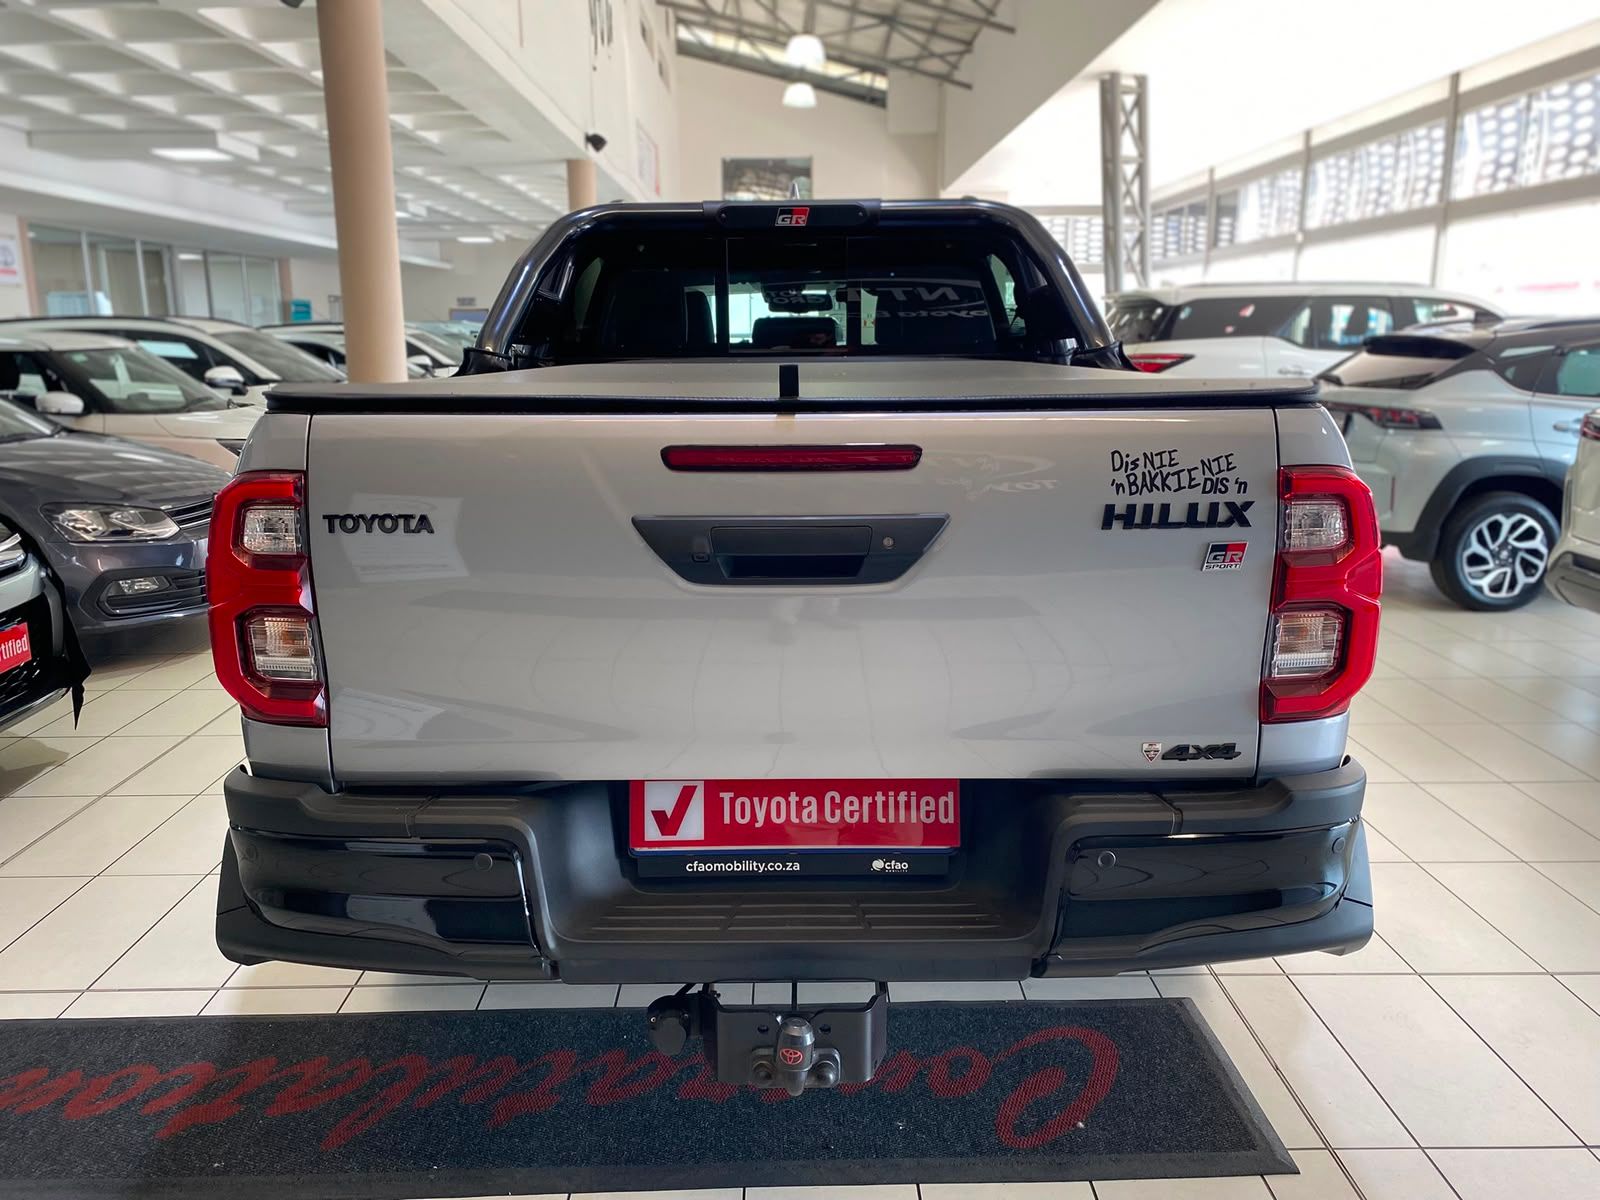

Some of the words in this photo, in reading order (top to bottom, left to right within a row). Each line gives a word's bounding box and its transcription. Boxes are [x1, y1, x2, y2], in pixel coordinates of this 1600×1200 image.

[777, 214, 806, 225] GR
[1110, 449, 1140, 473] Dis
[1142, 449, 1180, 470] NIE
[1126, 466, 1202, 497] BAKKIE
[1200, 453, 1237, 476] NIE
[1201, 477, 1230, 495] DIS
[322, 513, 435, 534] TOYOTA
[1101, 500, 1255, 530] HILUX
[1207, 550, 1245, 564] GR
[1205, 563, 1241, 571] SPORT
[719, 790, 818, 828] Toyota
[824, 790, 954, 824] Certified
[686, 860, 801, 874] cfaomobility.co.za
[885, 860, 909, 870] cfao
